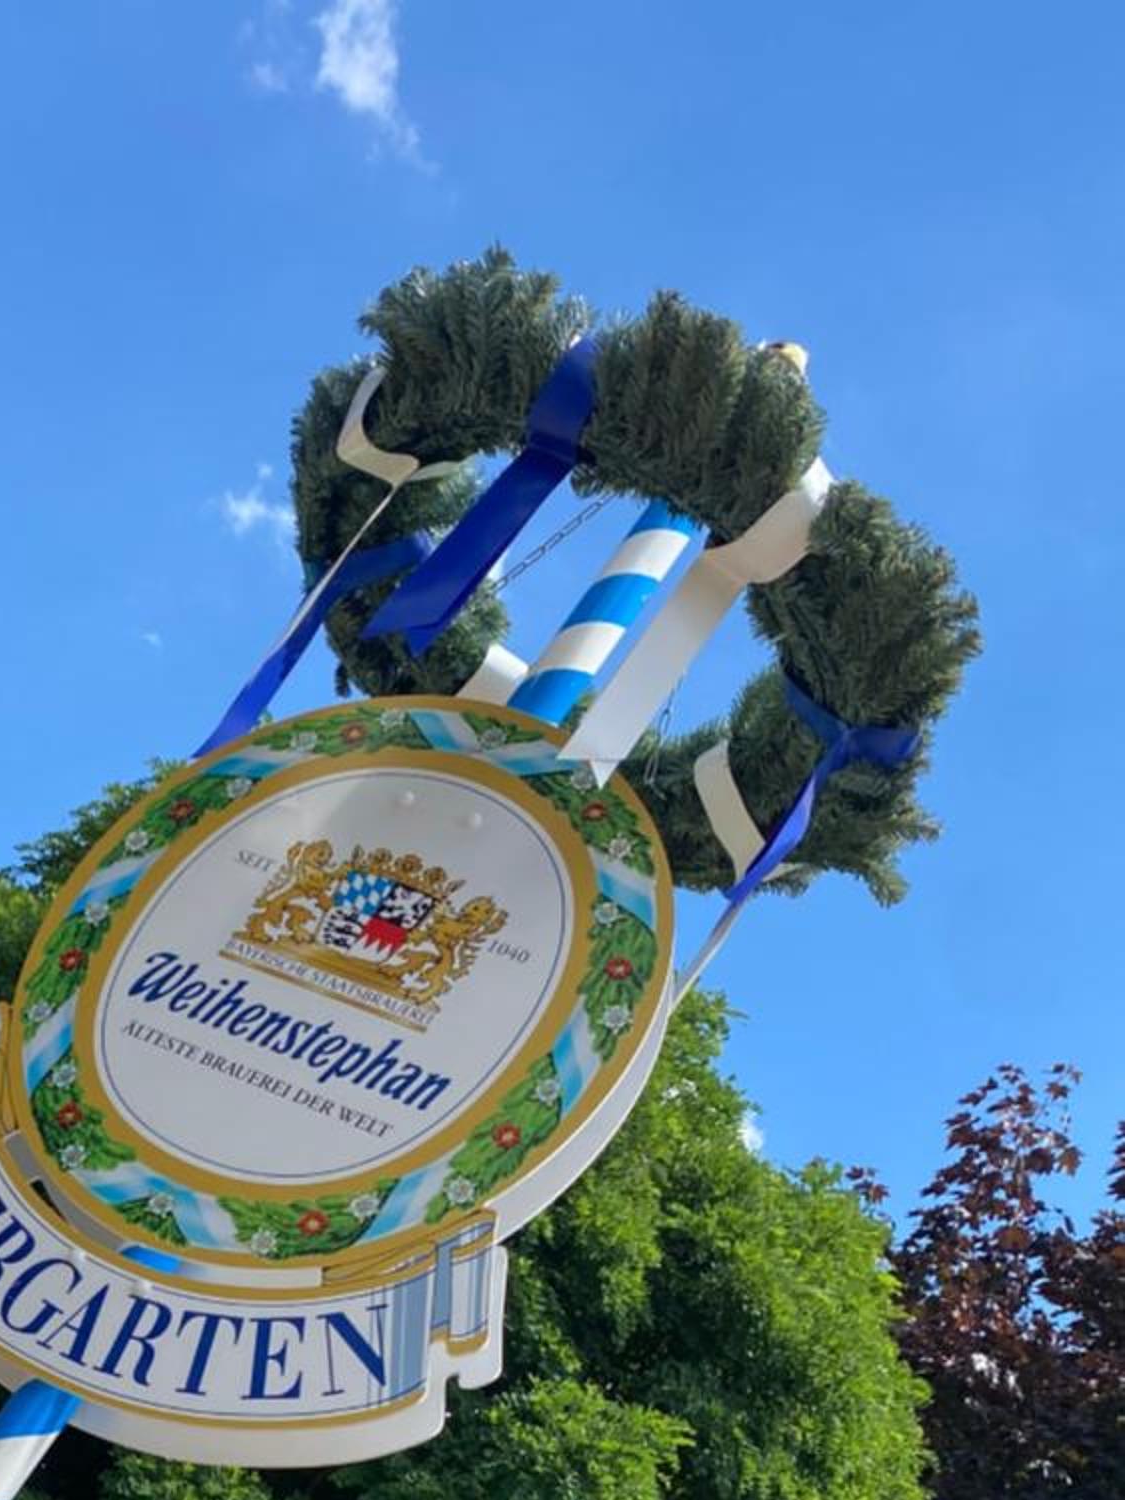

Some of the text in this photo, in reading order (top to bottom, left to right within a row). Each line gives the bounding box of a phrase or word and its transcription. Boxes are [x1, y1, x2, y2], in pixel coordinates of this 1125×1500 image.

[235, 850, 273, 873] SEIT
[485, 938, 531, 964] 1040
[311, 967, 435, 1025] STAATSBRAUEREI
[128, 951, 452, 1111] Weihenstephan
[200, 1050, 293, 1099] BRAUEREI
[292, 1086, 335, 1116] DER
[338, 1104, 394, 1138] WELT
